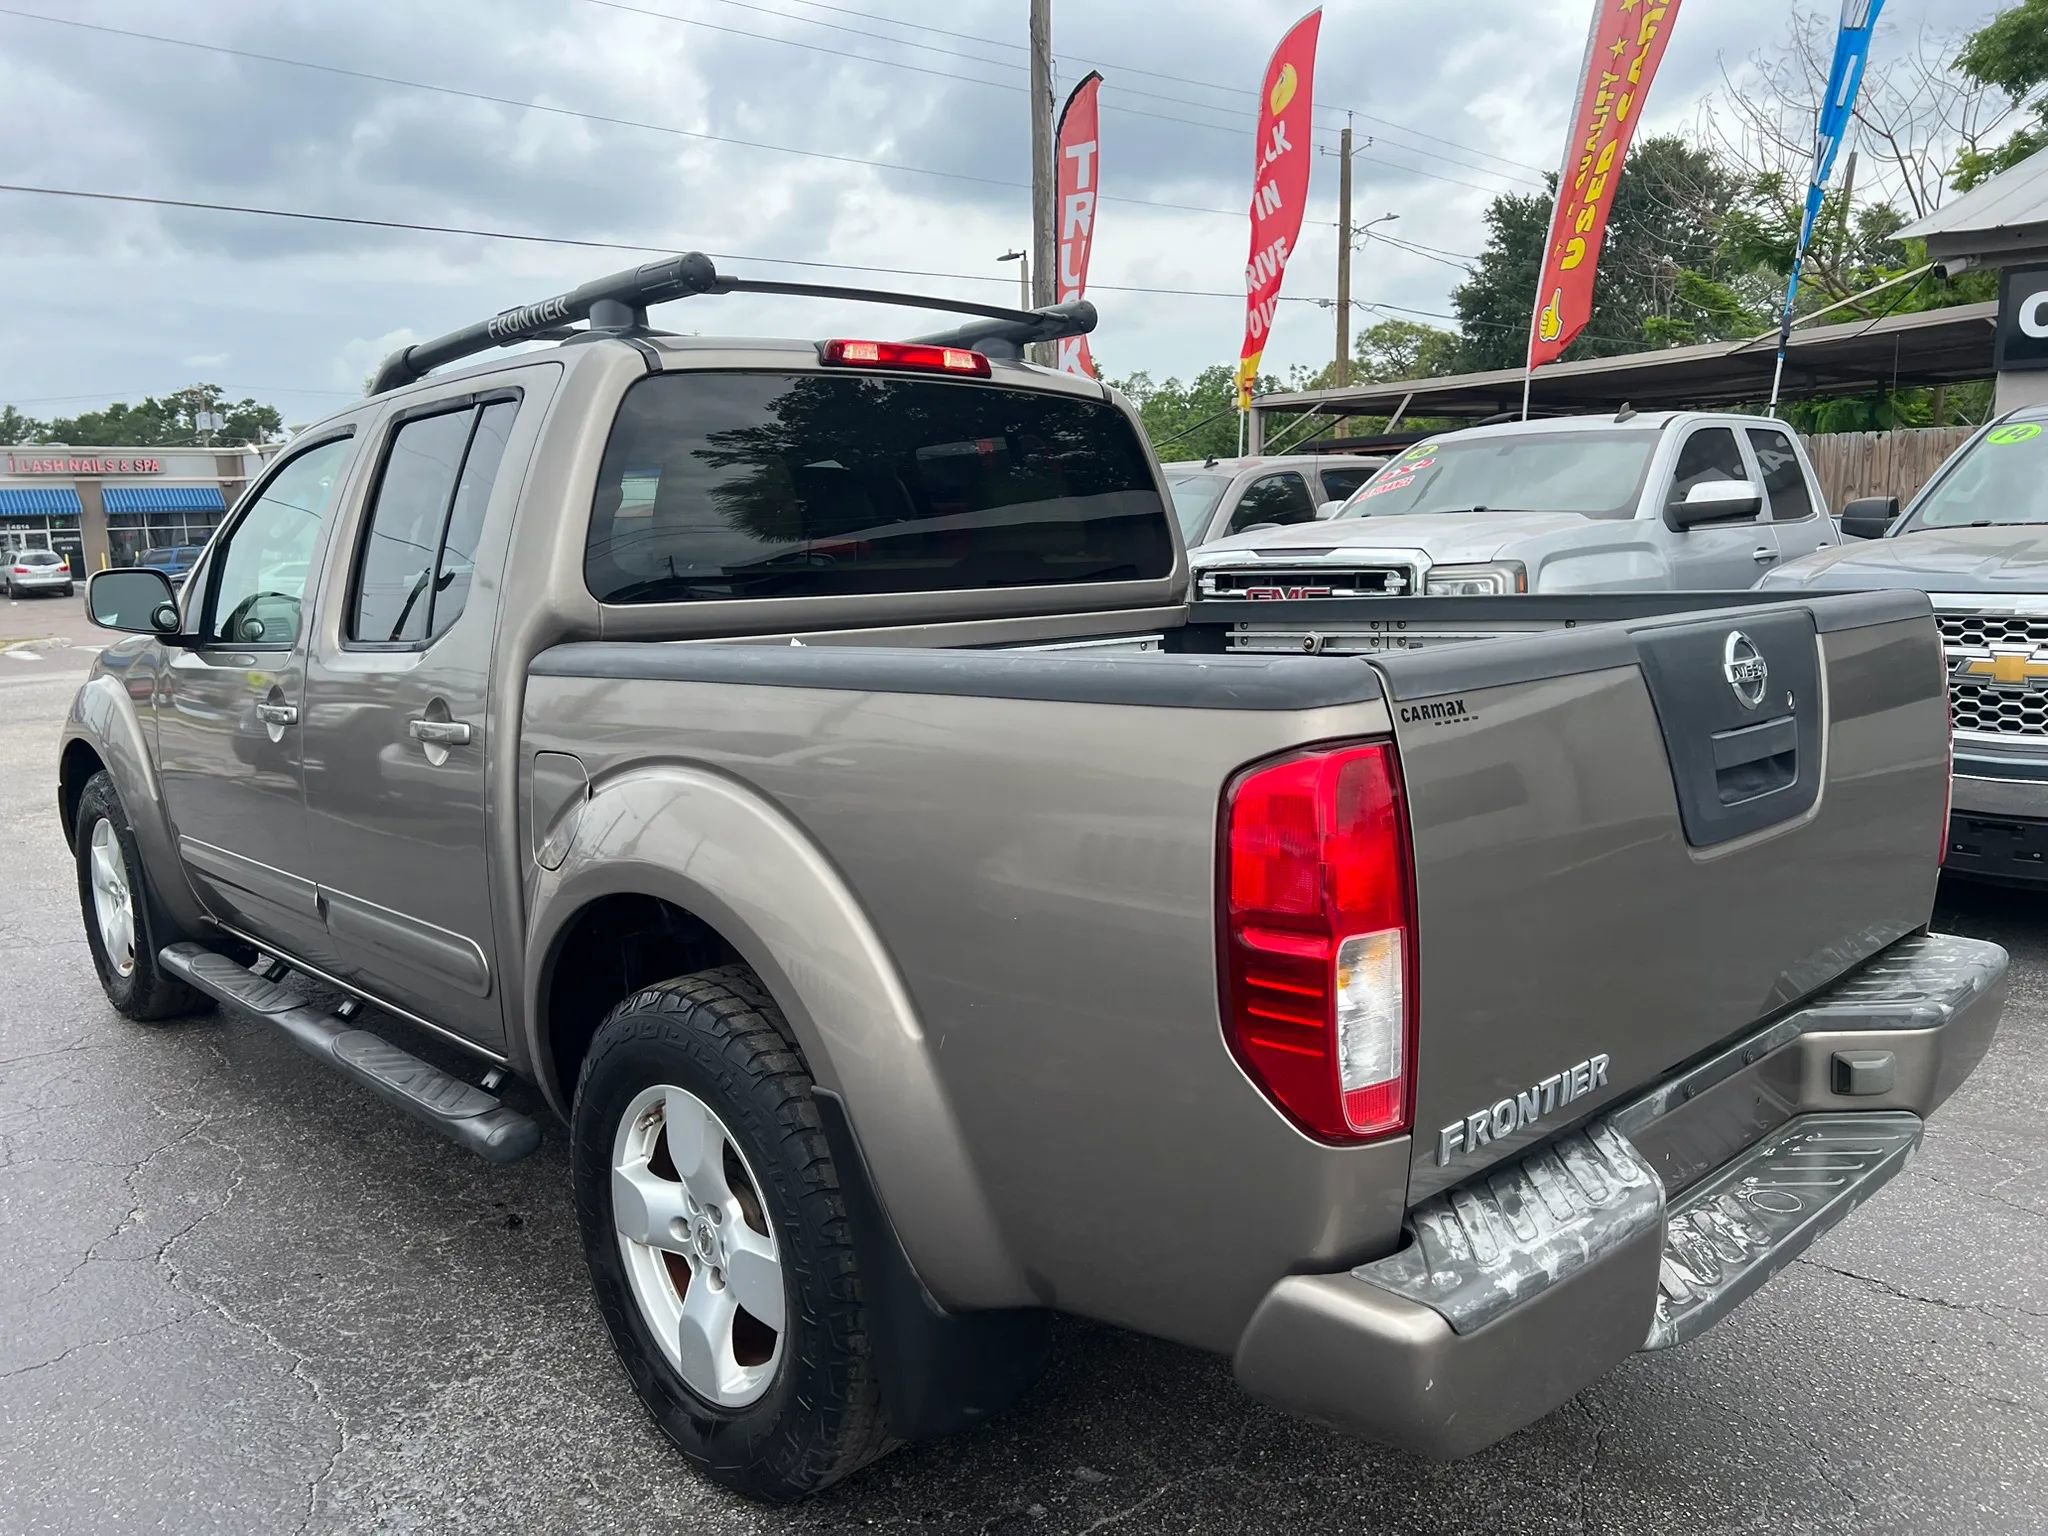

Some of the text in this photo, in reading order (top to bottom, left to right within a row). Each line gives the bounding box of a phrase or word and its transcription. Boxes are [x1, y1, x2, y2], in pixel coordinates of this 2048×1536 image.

[1559, 0, 1673, 271] USED CAR
[1575, 70, 1621, 191] QUALITY
[1254, 179, 1283, 222] IN
[1056, 140, 1098, 378] TRUK
[1245, 236, 1289, 295] RIVE
[487, 296, 570, 339] FRONTIER
[21, 459, 64, 473] LASH
[67, 457, 116, 473] NAILS
[119, 459, 129, 472] &
[134, 458, 161, 472] SPA
[1246, 587, 1331, 600] GMC
[1401, 700, 1466, 723] CARmax
[1435, 1053, 1610, 1168] FRONTIER
